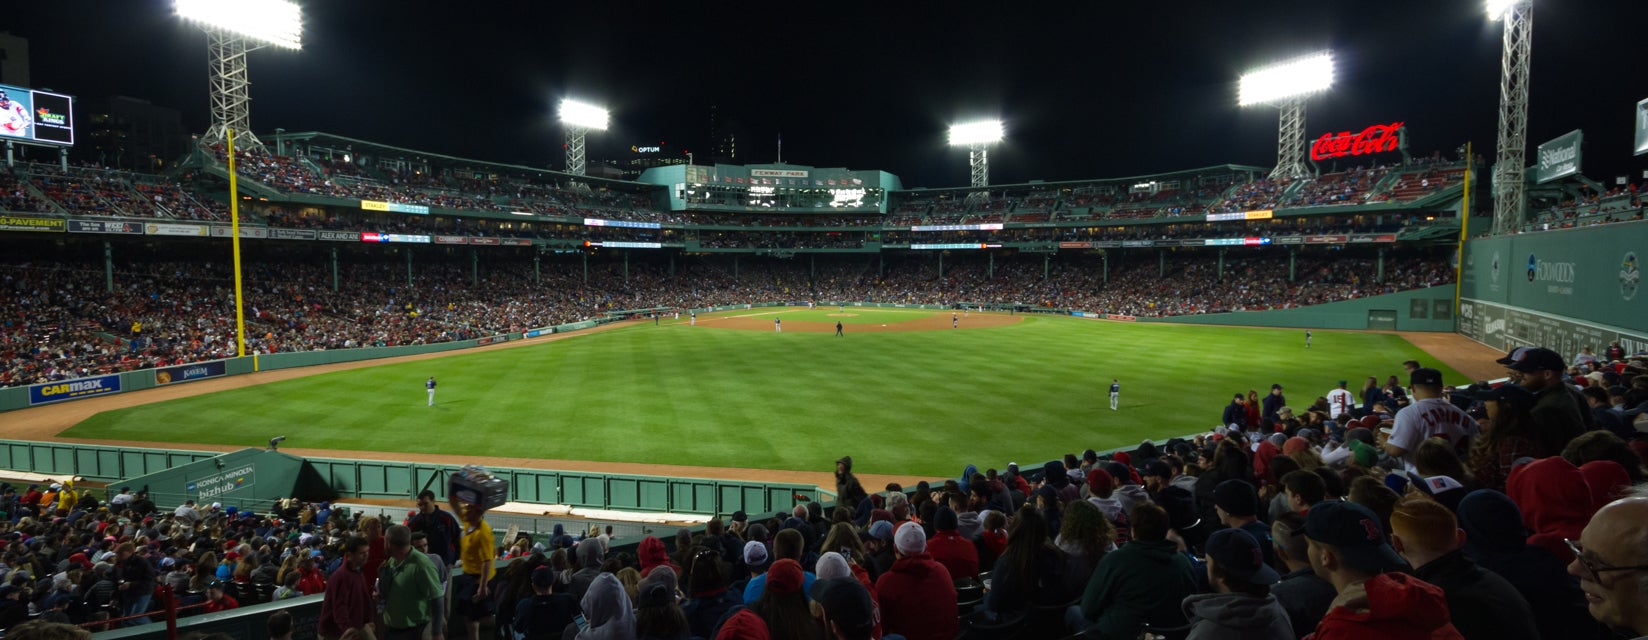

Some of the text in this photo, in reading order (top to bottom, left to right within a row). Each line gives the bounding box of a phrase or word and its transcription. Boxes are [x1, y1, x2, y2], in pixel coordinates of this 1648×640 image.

[1311, 122, 1405, 160] Coca-Cola
[1550, 141, 1576, 165] National
[1536, 259, 1575, 283] FOXWOODS
[183, 366, 208, 379] KAYEM
[41, 379, 103, 397] CARmax
[196, 466, 253, 489] KONICA MINOLTA
[199, 481, 234, 499] bizhub
